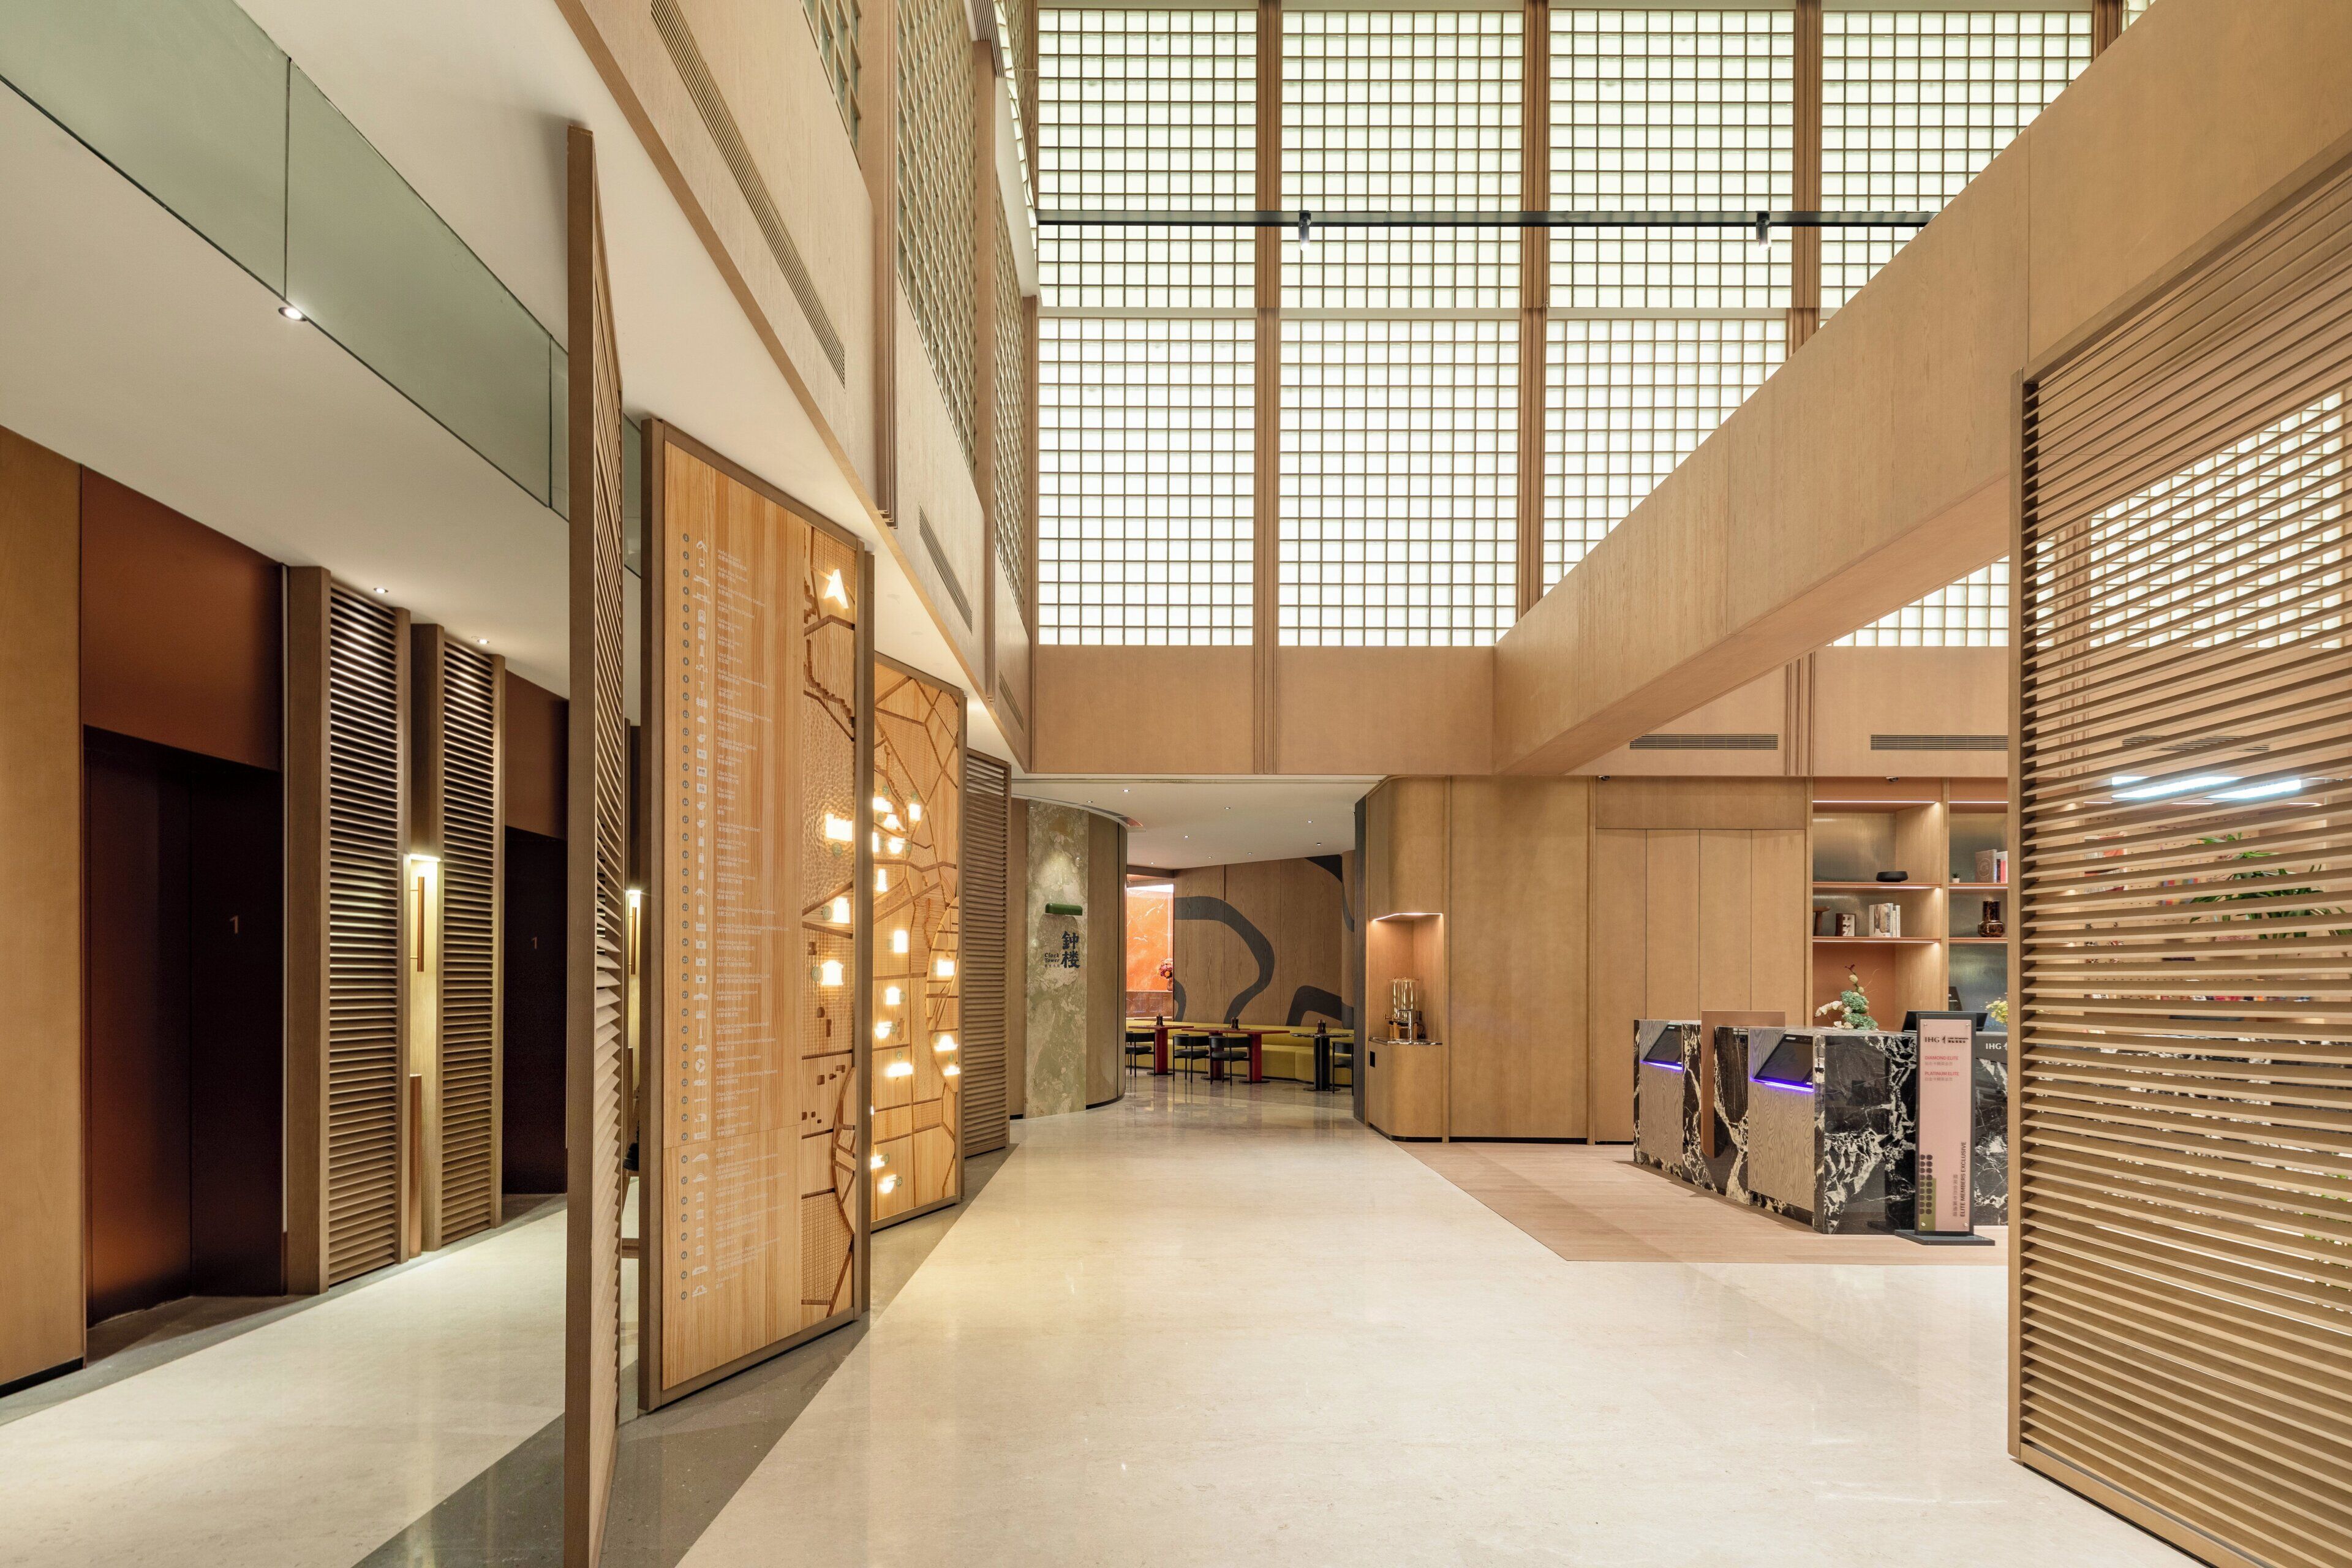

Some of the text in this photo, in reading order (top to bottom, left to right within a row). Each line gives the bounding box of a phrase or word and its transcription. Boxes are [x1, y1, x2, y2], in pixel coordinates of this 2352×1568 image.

[718, 548, 727, 557] Hefei
[718, 566, 727, 574] Hefei
[735, 574, 747, 583] Station
[717, 583, 727, 591] Hefei
[718, 600, 727, 608] Hefei
[230, 915, 238, 934] 1
[532, 937, 537, 949] 1
